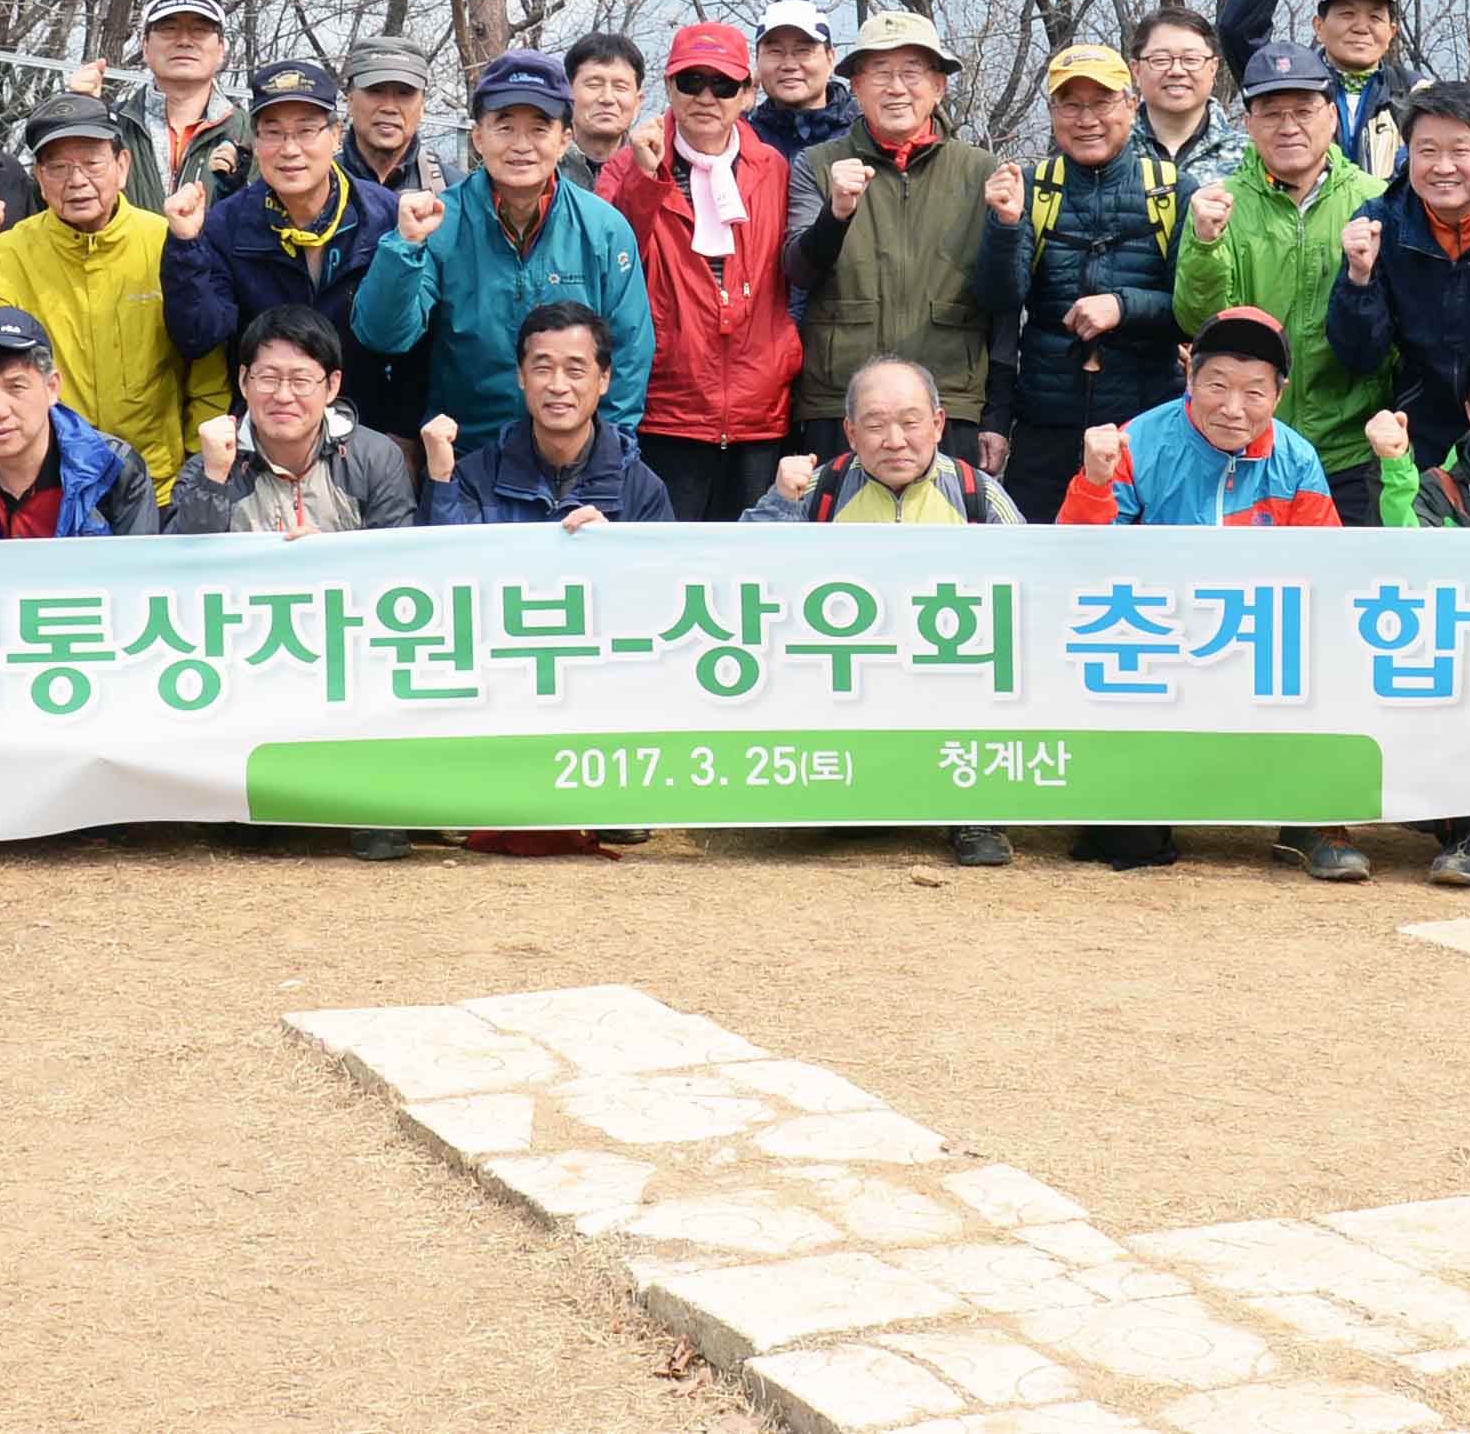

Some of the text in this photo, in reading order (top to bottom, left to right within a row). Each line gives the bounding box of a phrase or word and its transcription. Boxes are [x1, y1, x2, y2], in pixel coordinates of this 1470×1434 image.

[1065, 584, 1302, 697] 춘계
[553, 740, 1073, 789] 2017. 3. 25(토) 청계산
